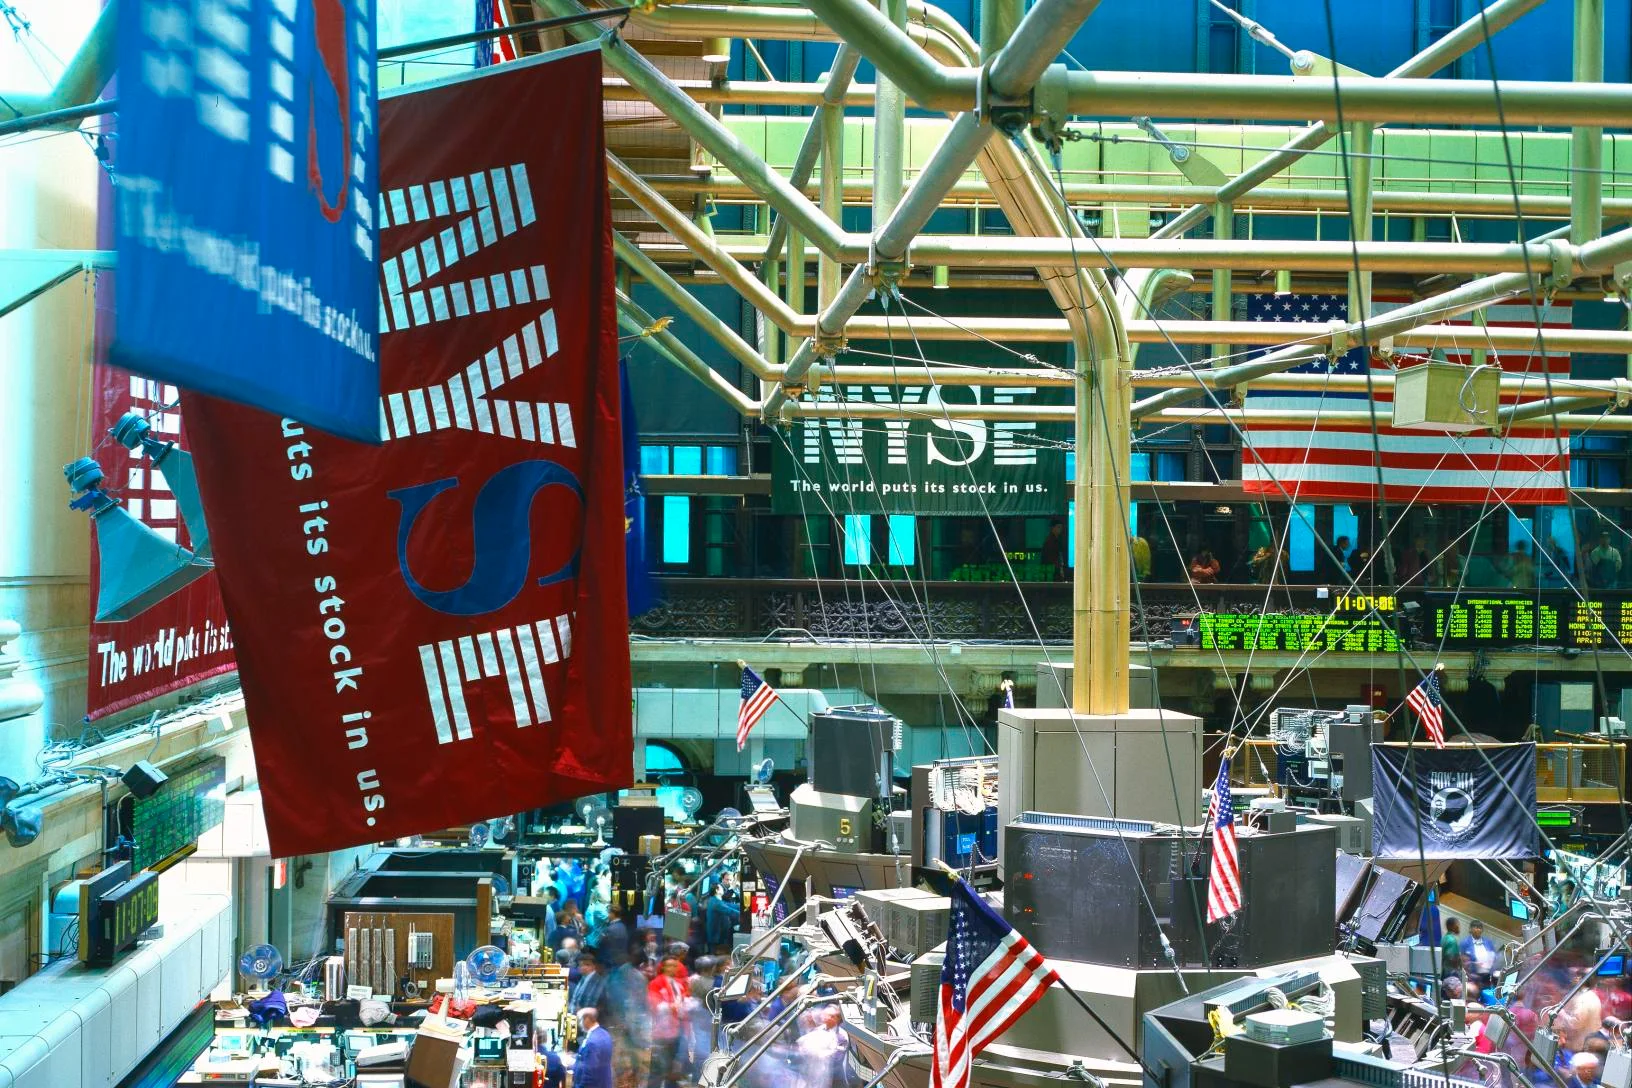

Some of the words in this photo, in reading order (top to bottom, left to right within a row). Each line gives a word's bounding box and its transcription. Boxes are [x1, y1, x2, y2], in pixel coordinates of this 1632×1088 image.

[804, 385, 1037, 466] NYSE
[379, 162, 586, 745] NYSE
[790, 479, 821, 493] The
[828, 479, 874, 493] world
[882, 483, 917, 496] puts
[924, 481, 945, 493] its
[952, 481, 996, 494] stock
[1003, 481, 1018, 494] in
[1025, 483, 1048, 494] us.
[281, 416, 313, 481] uts
[299, 501, 329, 556] its
[314, 575, 363, 694] stock
[342, 710, 372, 751] in
[357, 768, 386, 828] us.
[97, 640, 127, 687] The
[1431, 772, 1451, 798] POW
[840, 818, 851, 835] 5
